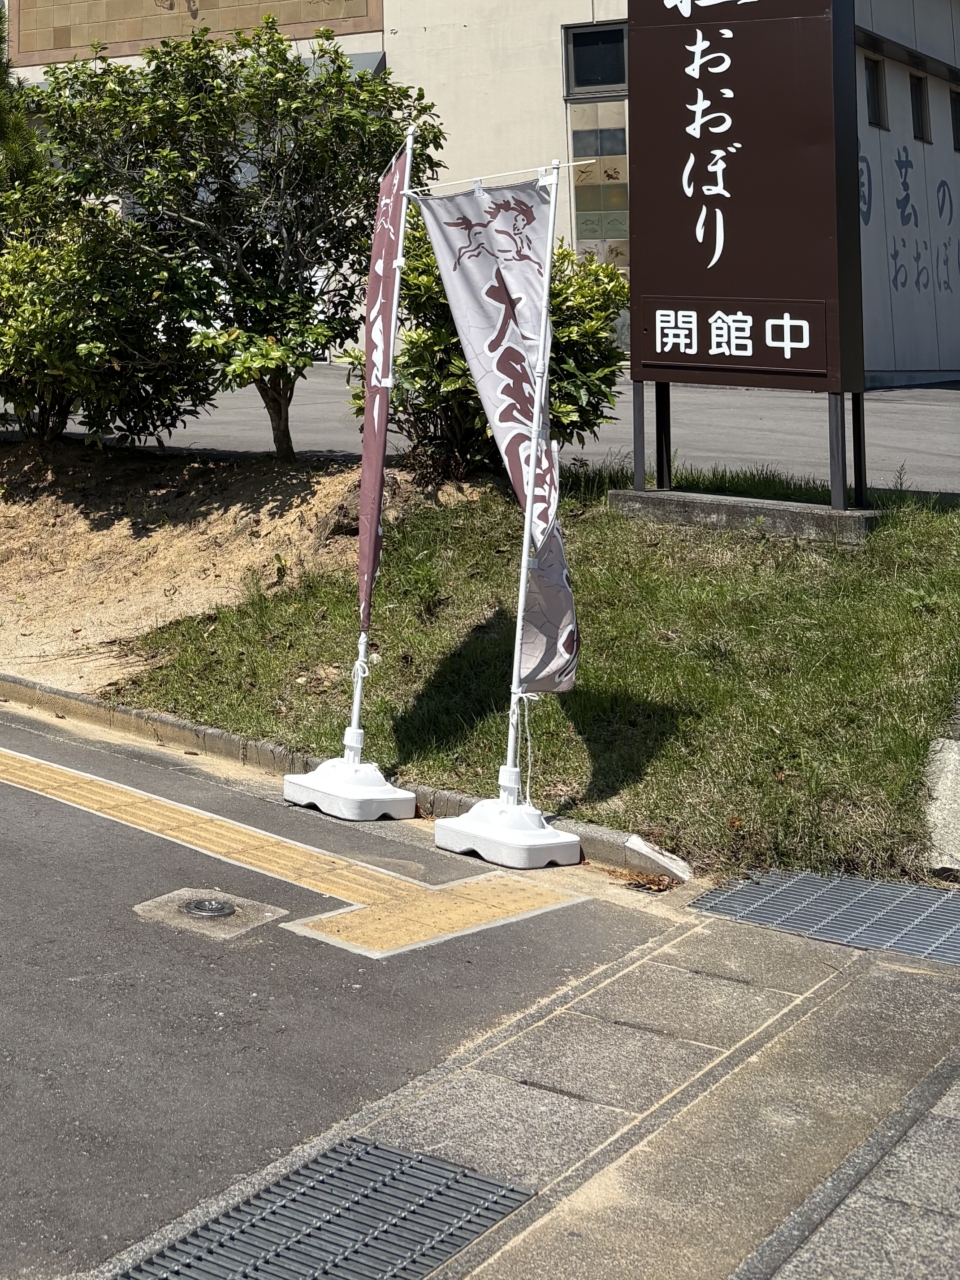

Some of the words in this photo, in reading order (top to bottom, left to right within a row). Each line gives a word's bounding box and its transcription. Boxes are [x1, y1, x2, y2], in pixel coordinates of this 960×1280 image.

[681, 28, 743, 269] おおぼり
[655, 309, 810, 359] 開館中
